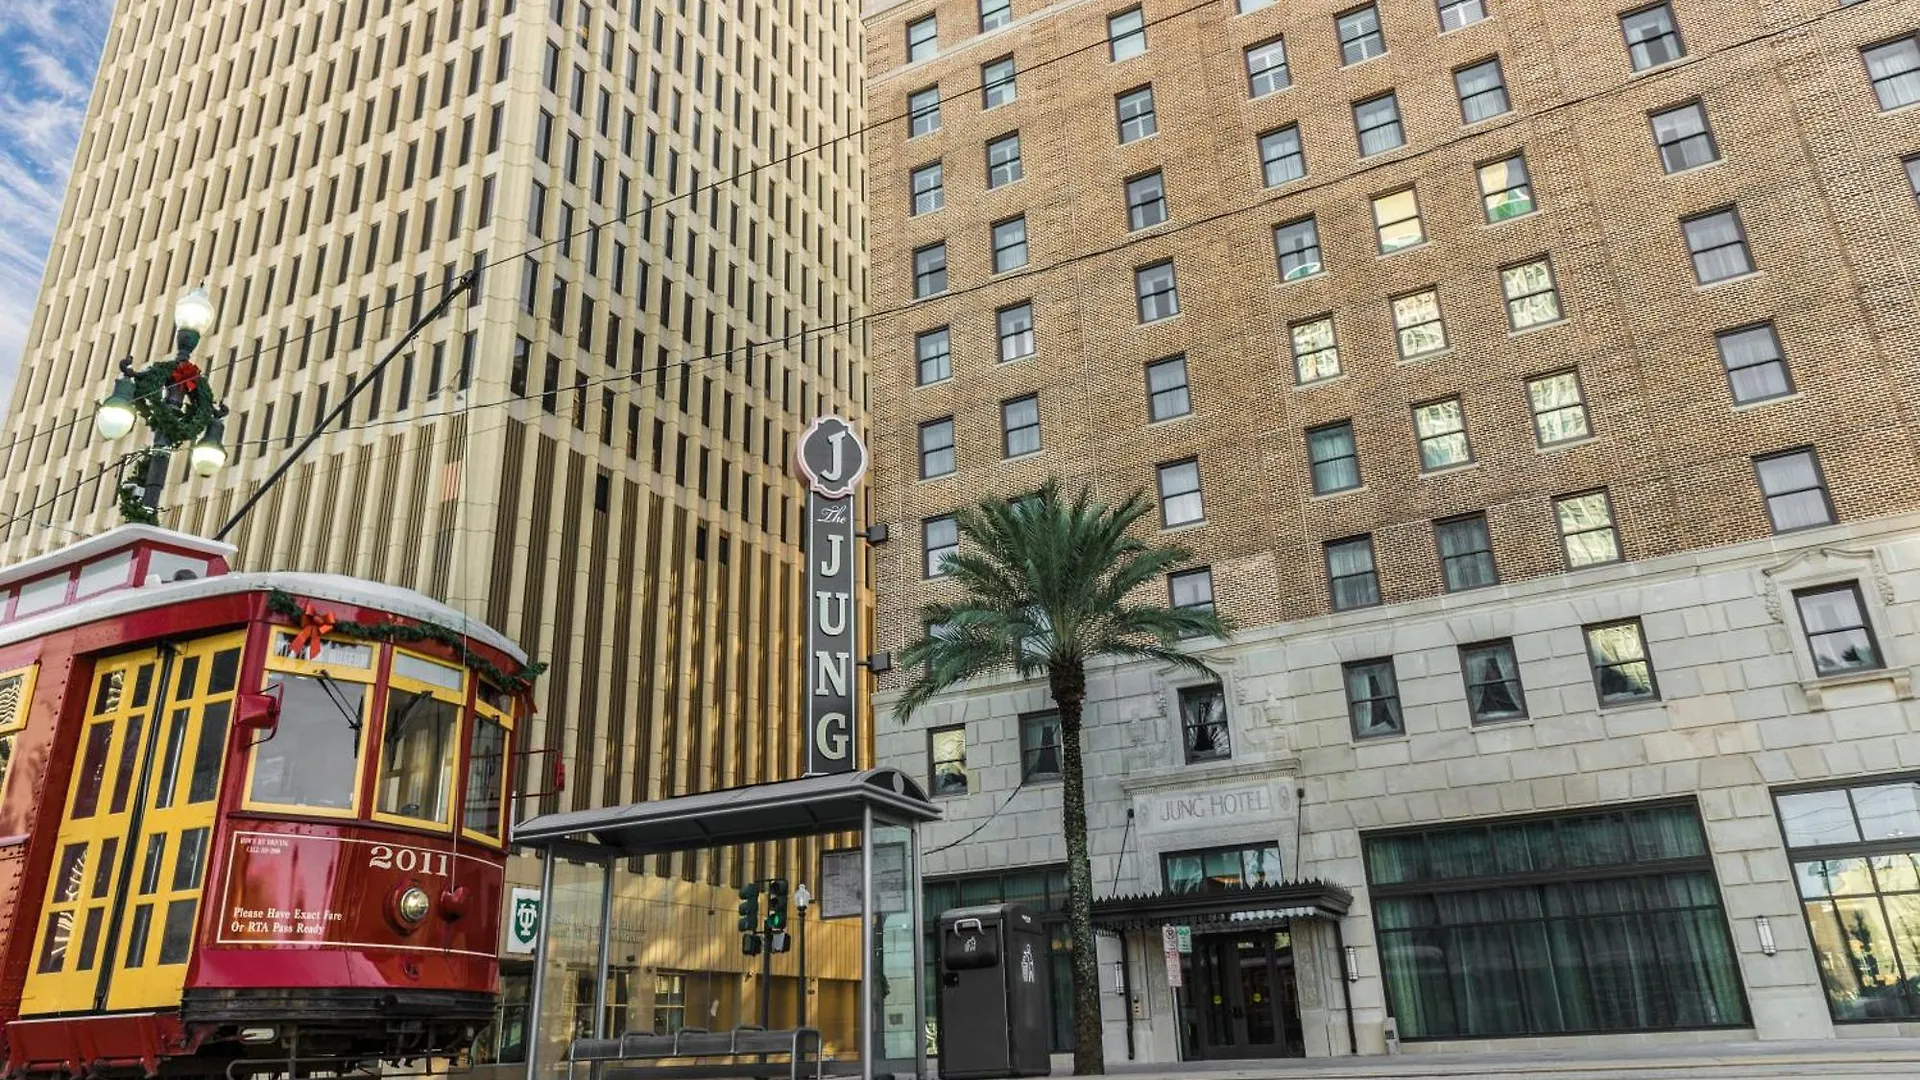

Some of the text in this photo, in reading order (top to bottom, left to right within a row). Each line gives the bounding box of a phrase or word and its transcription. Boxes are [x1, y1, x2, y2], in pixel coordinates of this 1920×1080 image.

[820, 430, 846, 482] J
[816, 505, 848, 524] The
[815, 534, 850, 760] JUNG
[1161, 791, 1270, 821] JUNG HOTEL
[369, 845, 448, 877] 2011
[231, 921, 324, 935] Or RTA Pass Ready
[233, 906, 263, 919] Please
[267, 907, 290, 919] Have
[294, 909, 320, 920] Exact
